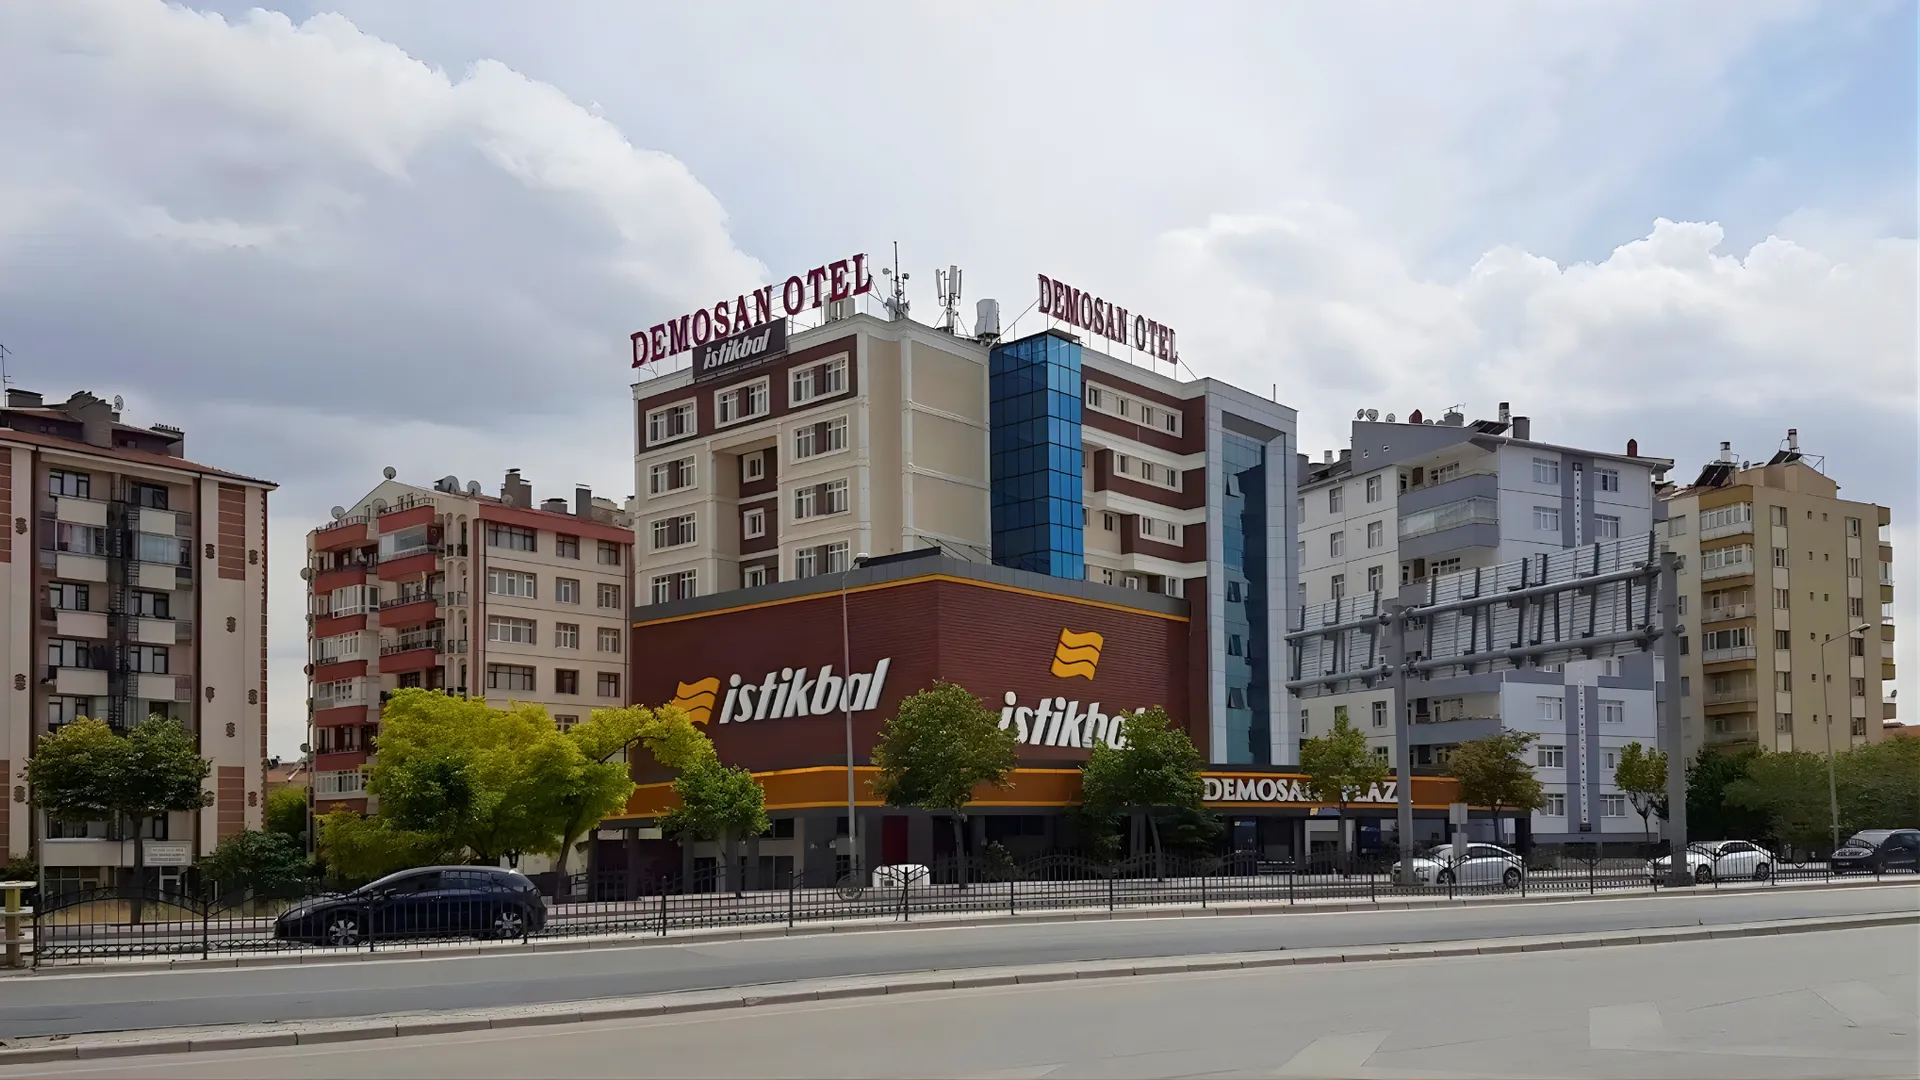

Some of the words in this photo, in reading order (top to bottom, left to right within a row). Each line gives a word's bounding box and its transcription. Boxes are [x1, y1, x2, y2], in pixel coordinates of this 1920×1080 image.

[631, 285, 772, 368] DEMOSAN
[783, 253, 873, 316] OTEL
[1038, 274, 1128, 345] DEMOSAN
[1135, 314, 1178, 365] OTEL
[703, 328, 771, 370] istikbal
[719, 657, 891, 724] istikbal
[998, 691, 1145, 751] istikba
